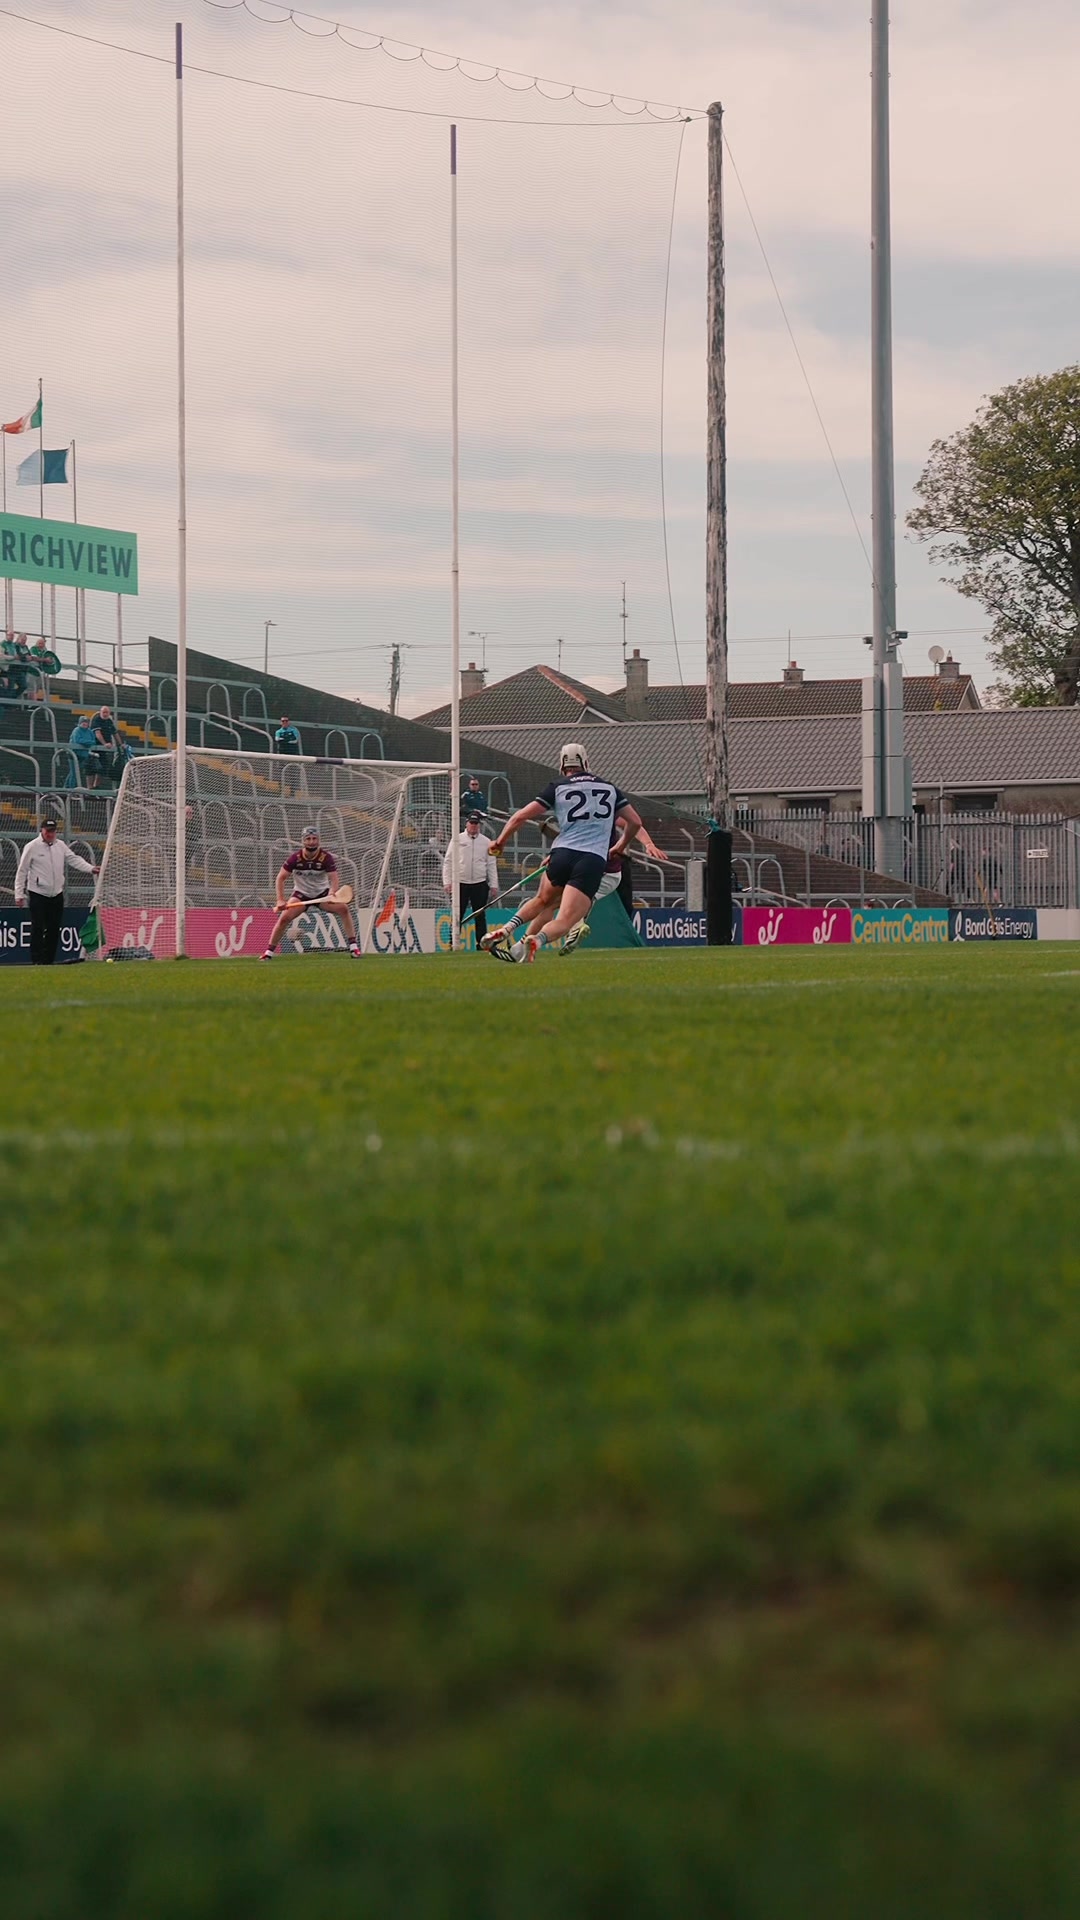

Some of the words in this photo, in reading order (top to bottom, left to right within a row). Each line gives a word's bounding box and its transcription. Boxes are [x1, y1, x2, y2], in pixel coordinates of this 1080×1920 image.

[1, 529, 133, 578] RICHVIEW
[565, 788, 612, 822] 23
[20, 921, 81, 951] Egy
[215, 910, 253, 957] eir
[645, 918, 673, 939] Bord
[674, 917, 699, 938] Gáis
[758, 908, 784, 945] eir
[813, 909, 837, 944] eir
[965, 918, 985, 935] Bord
[1005, 918, 1033, 938] Energy
